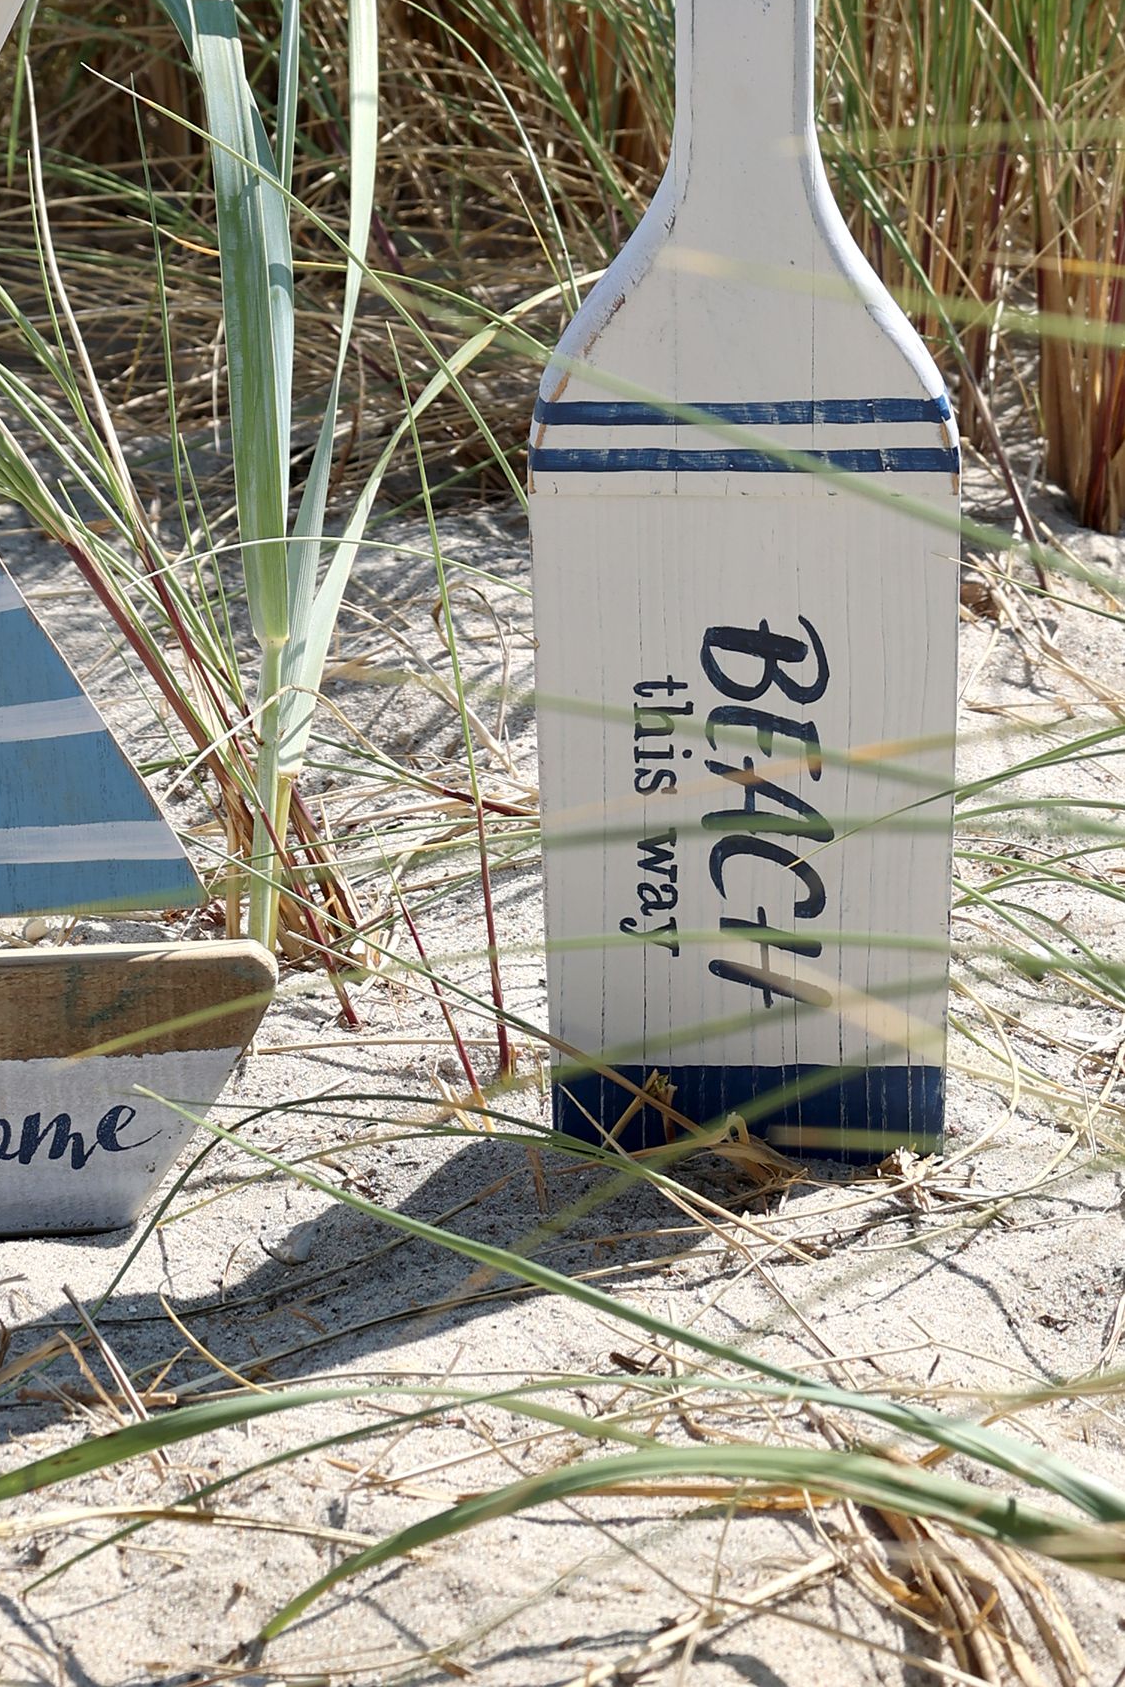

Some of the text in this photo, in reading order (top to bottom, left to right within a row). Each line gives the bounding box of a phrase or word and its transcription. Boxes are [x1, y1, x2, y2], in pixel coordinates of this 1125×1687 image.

[619, 673, 694, 958] this way
[701, 614, 835, 1009] BEACH
